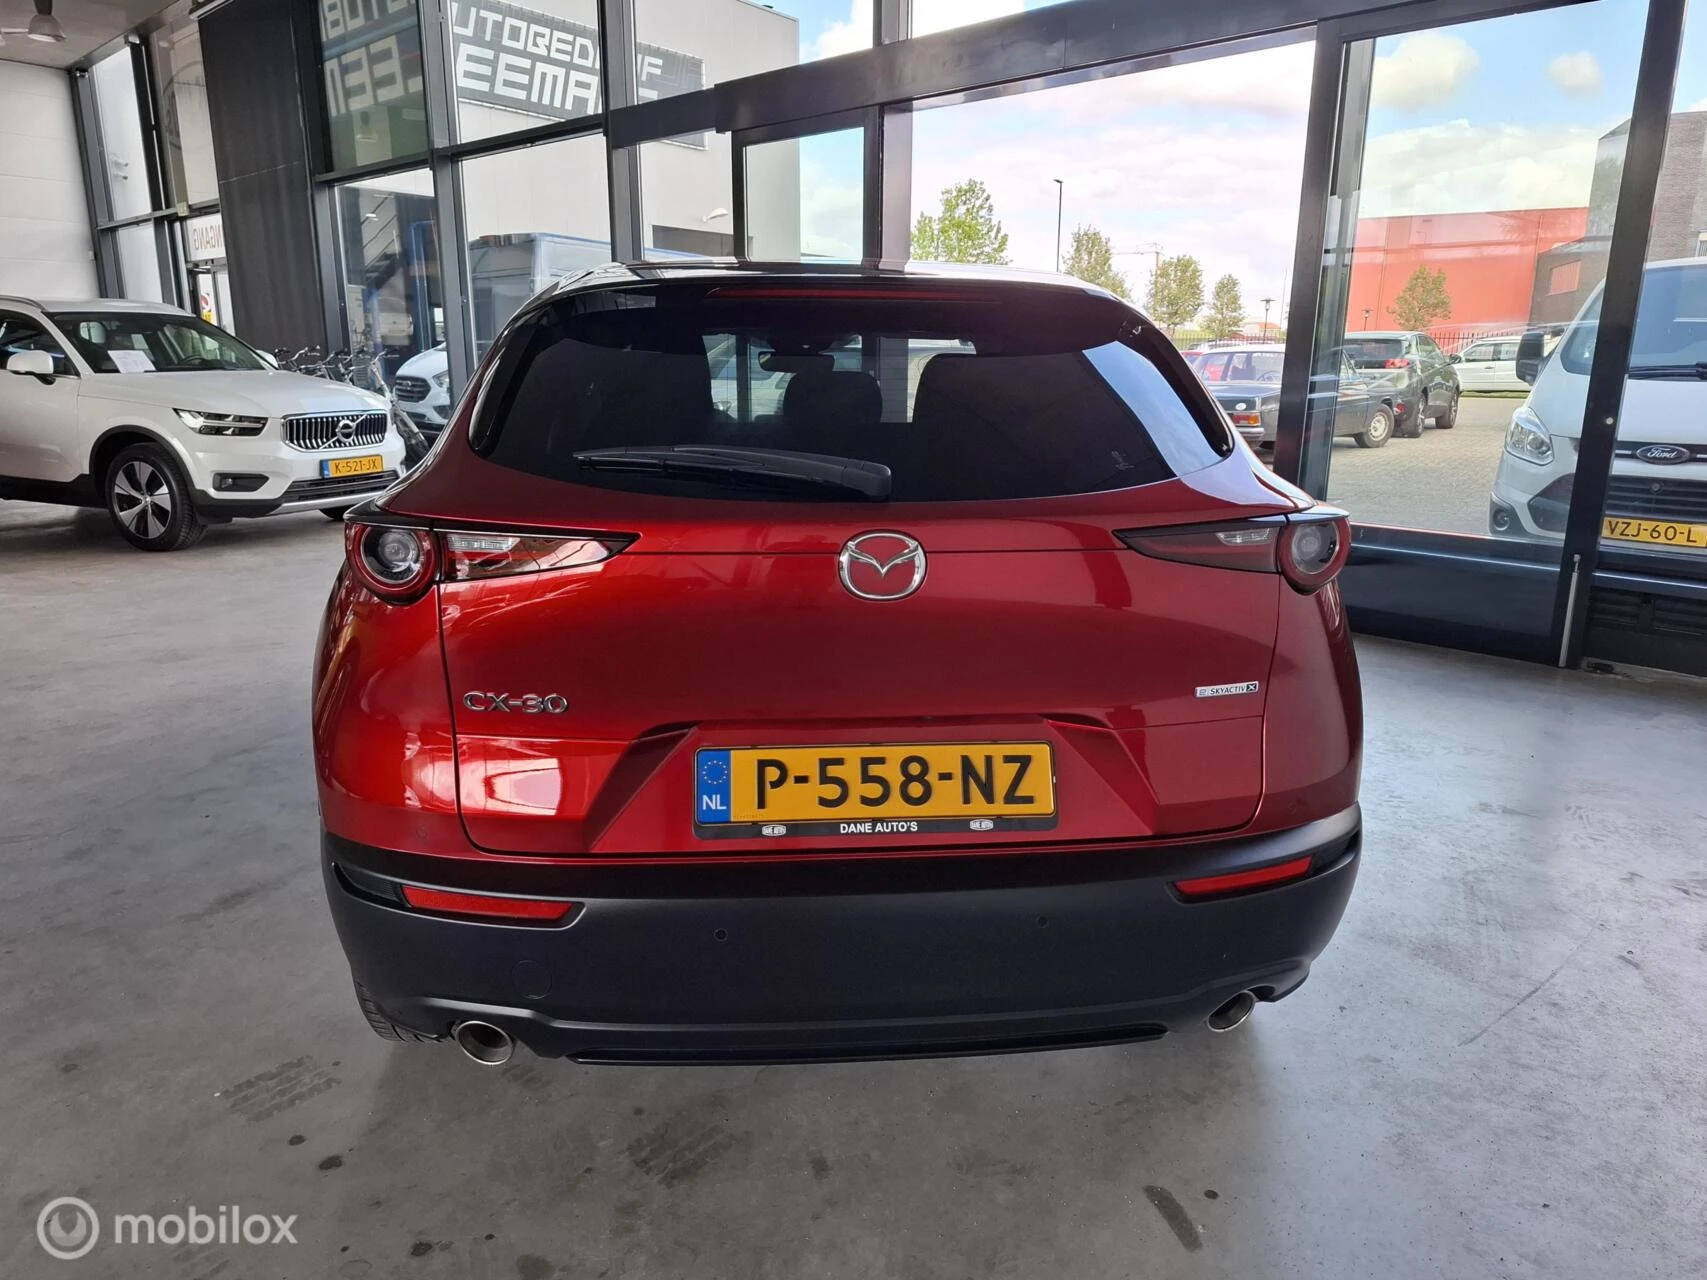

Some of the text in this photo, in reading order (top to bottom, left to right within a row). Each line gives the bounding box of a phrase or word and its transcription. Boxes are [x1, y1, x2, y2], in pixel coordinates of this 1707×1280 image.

[1647, 445, 1678, 459] Ford
[334, 459, 378, 474] K-521-JX
[1607, 520, 1697, 543] VZJ-60-L
[463, 691, 568, 713] CX-30
[756, 755, 1036, 810] P-558-NZ
[702, 794, 727, 811] NL
[840, 822, 873, 834] DANE
